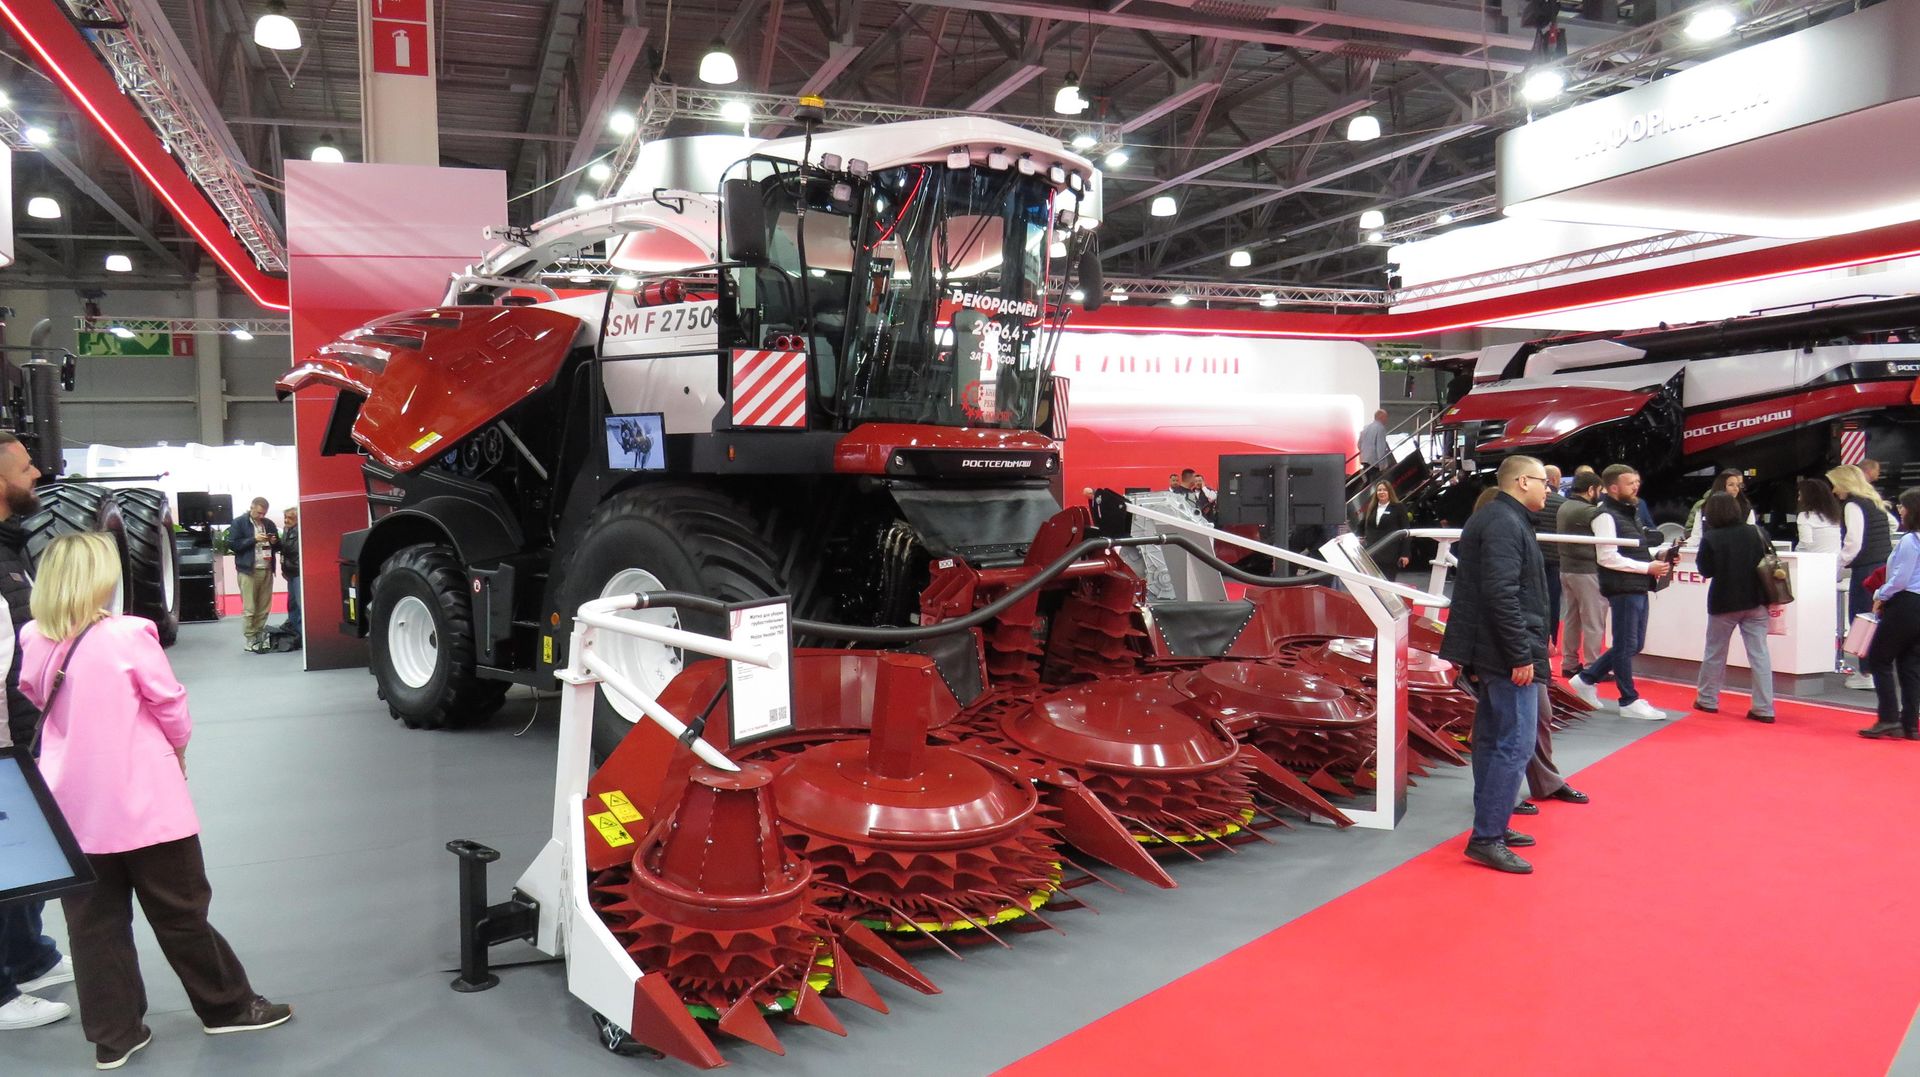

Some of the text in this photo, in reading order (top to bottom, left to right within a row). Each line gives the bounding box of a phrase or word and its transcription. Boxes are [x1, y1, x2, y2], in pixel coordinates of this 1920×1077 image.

[952, 289, 1038, 317] РЕКОРДСМЕН
[645, 311, 657, 334] F
[660, 305, 714, 333] 2750
[1683, 409, 1792, 439] РОСТСЕЛЬМАШ
[962, 459, 1032, 468] РОСТСЕЛЬМАШ
